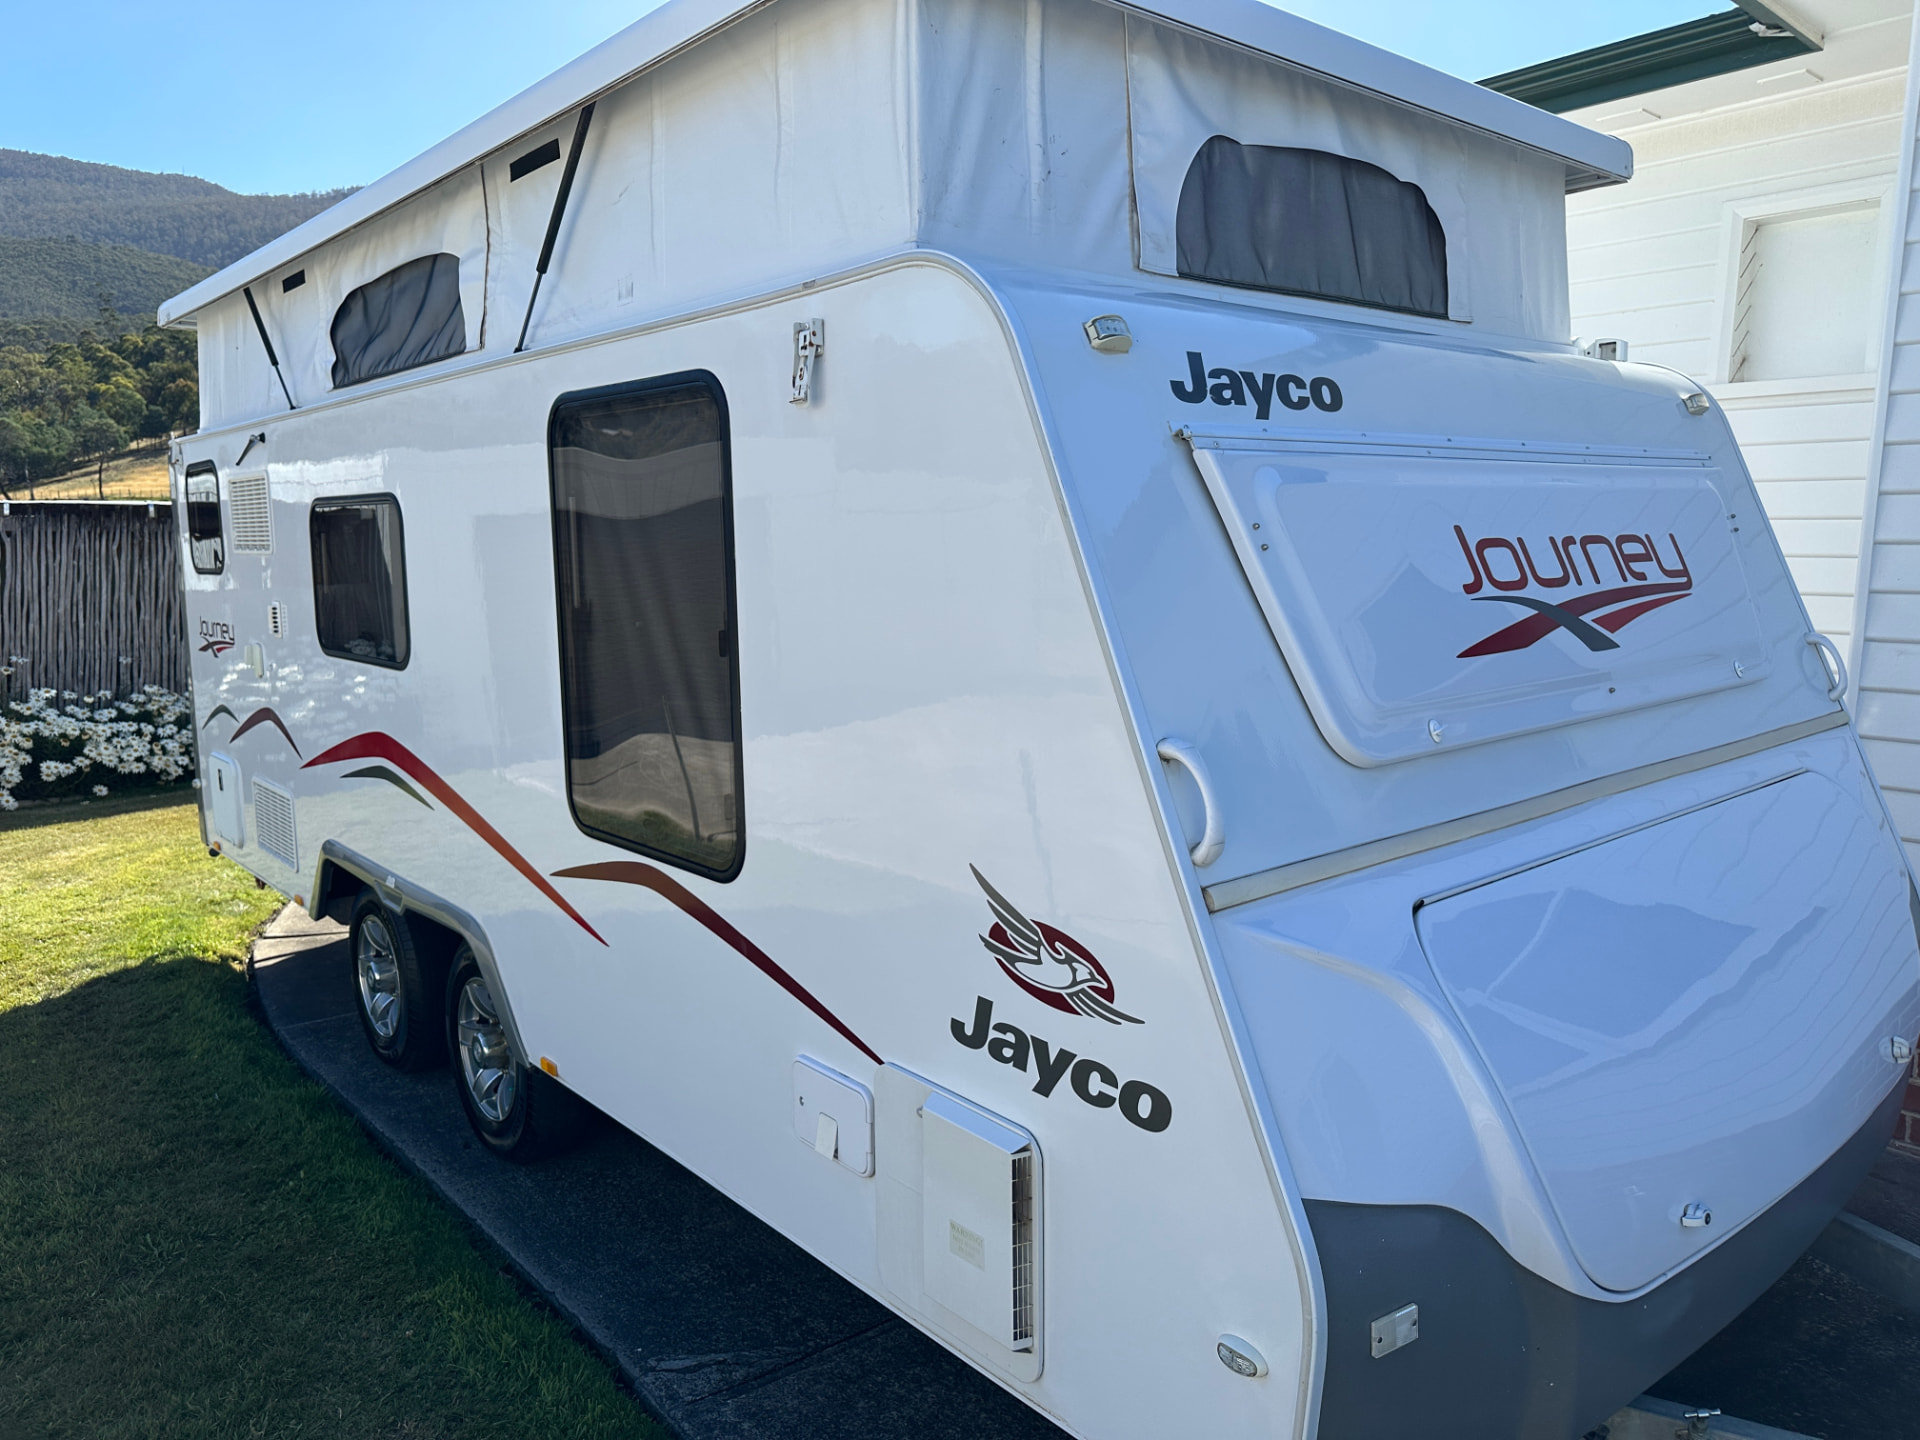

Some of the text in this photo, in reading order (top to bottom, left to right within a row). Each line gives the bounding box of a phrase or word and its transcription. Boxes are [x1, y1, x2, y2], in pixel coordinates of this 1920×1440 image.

[1169, 351, 1343, 420] Jayco
[1453, 525, 1693, 595] Journey
[199, 615, 235, 645] Journey
[950, 995, 1173, 1133] Jayco
